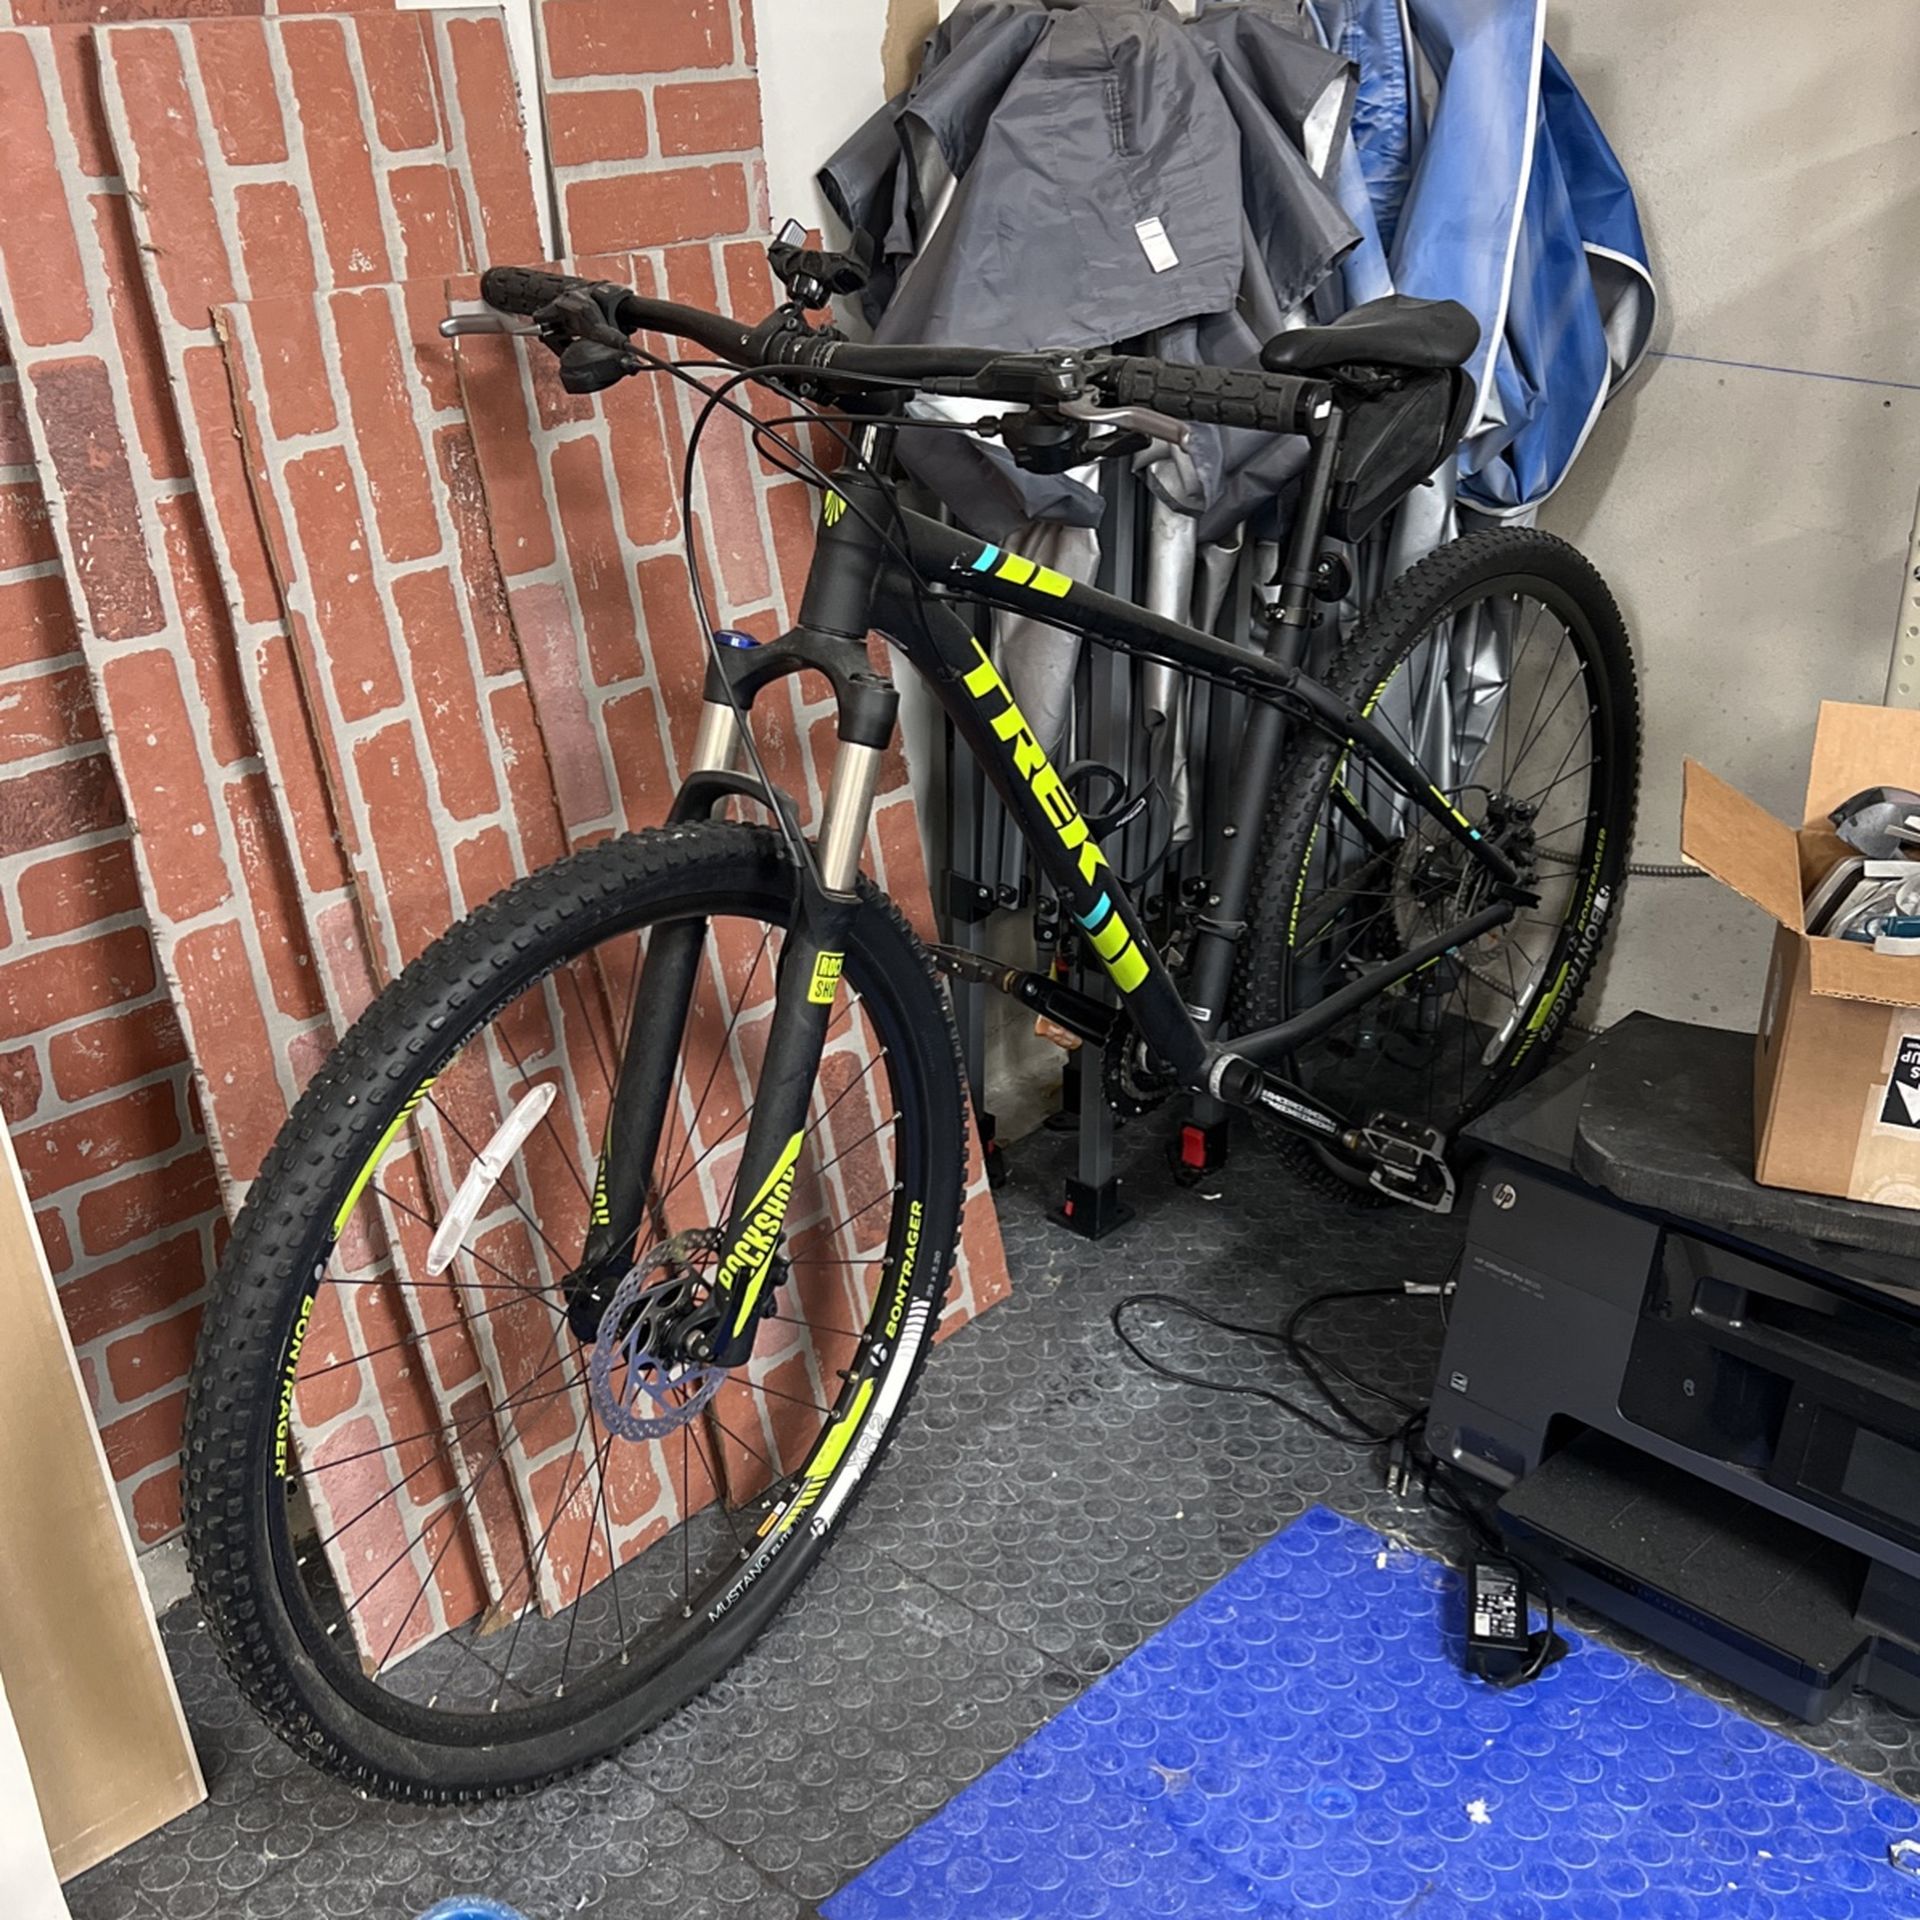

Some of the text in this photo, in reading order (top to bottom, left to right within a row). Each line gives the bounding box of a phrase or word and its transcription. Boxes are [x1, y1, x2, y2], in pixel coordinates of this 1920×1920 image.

[962, 636, 1110, 886] TREK
[1577, 827, 1607, 932] BONTRAGER
[814, 980, 836, 998] SHO
[818, 955, 844, 977] ROC
[1540, 906, 1604, 1043] BONTRAGER
[884, 1200, 923, 1340] BONTRAGER
[273, 1294, 314, 1478] BONTRAGER
[847, 1411, 890, 1475] XR2
[708, 1554, 771, 1623] MUSTANG
